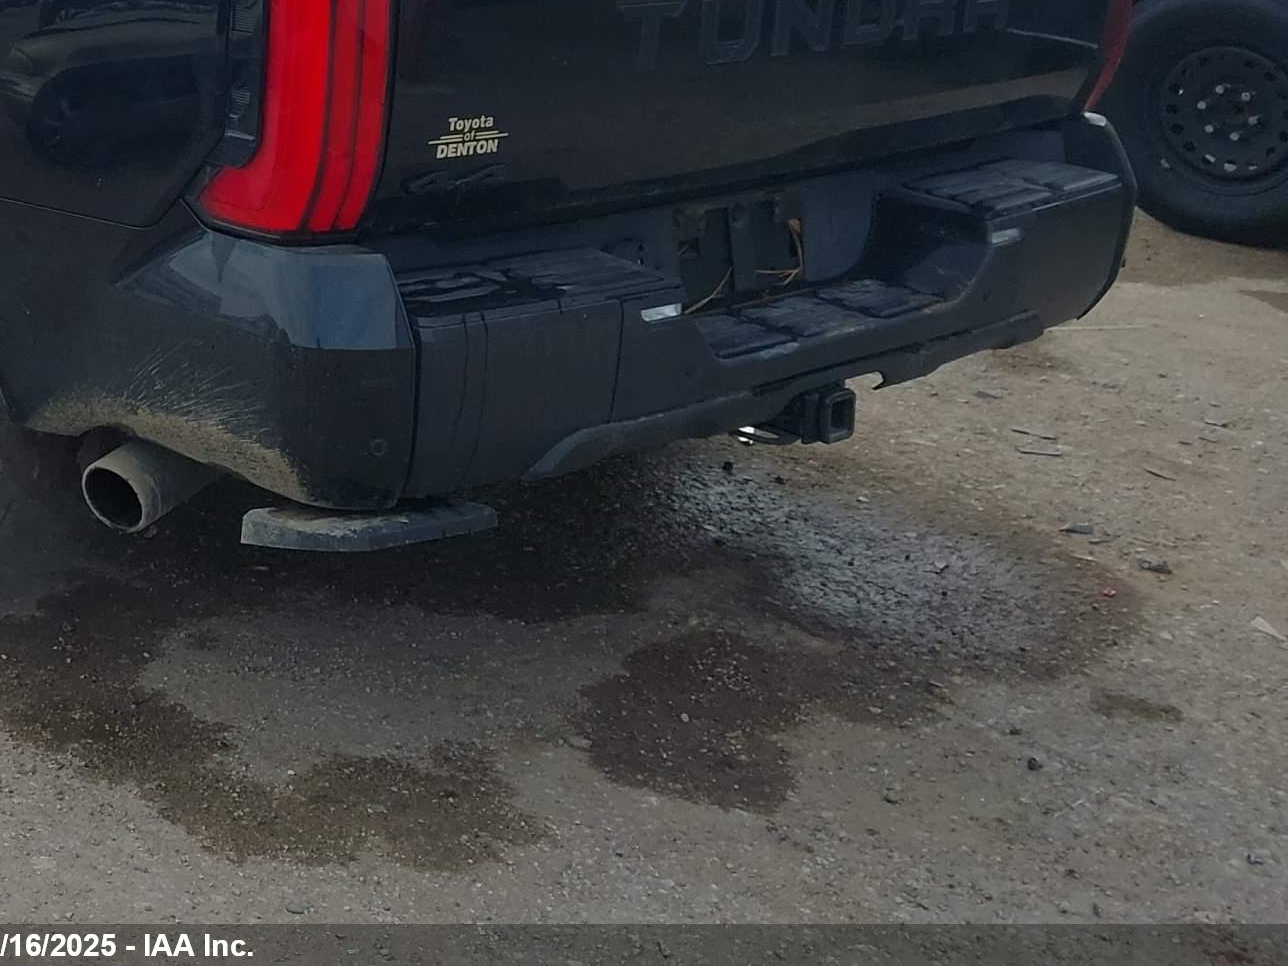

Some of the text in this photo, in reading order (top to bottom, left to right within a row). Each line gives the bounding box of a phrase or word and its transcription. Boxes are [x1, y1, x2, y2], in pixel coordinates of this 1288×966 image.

[448, 115, 494, 132] Toyota
[463, 130, 475, 142] of
[436, 139, 499, 159] DENTON
